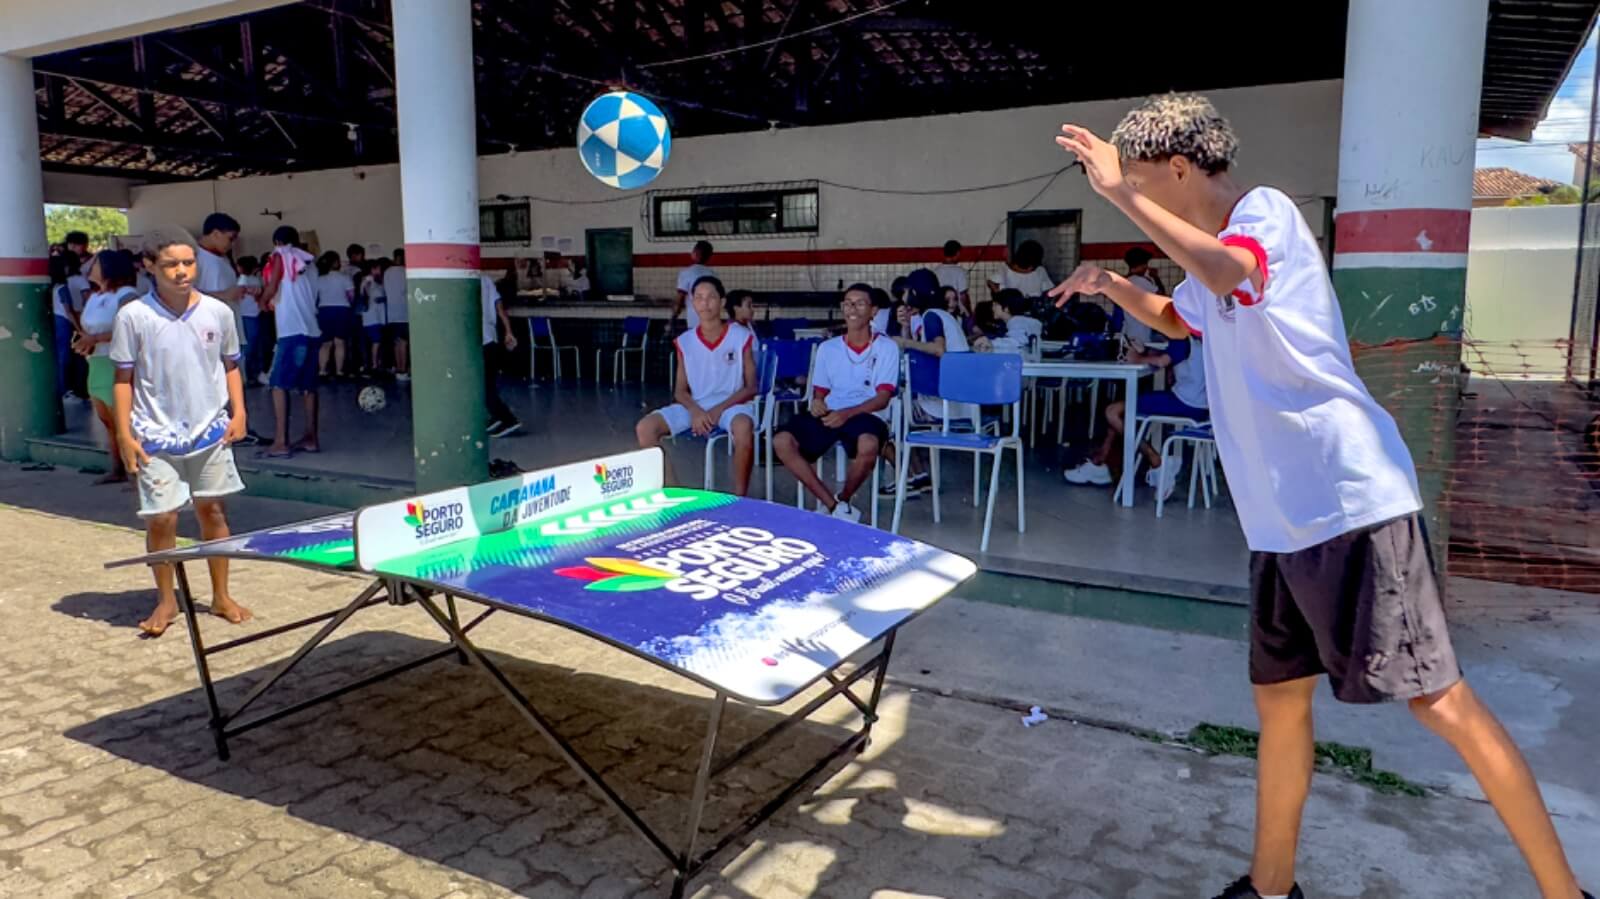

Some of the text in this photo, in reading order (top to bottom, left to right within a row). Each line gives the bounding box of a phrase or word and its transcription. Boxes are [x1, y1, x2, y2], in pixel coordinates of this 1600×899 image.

[601, 477, 634, 494] SEGURO
[605, 465, 634, 481] PORTO
[490, 475, 556, 515] CARAVANA
[503, 485, 572, 529] DA JUVENTUDE
[415, 516, 463, 539] SEGURO
[423, 503, 463, 523] PORTO
[640, 527, 775, 574] PORTO
[664, 538, 818, 601] SEGURO
